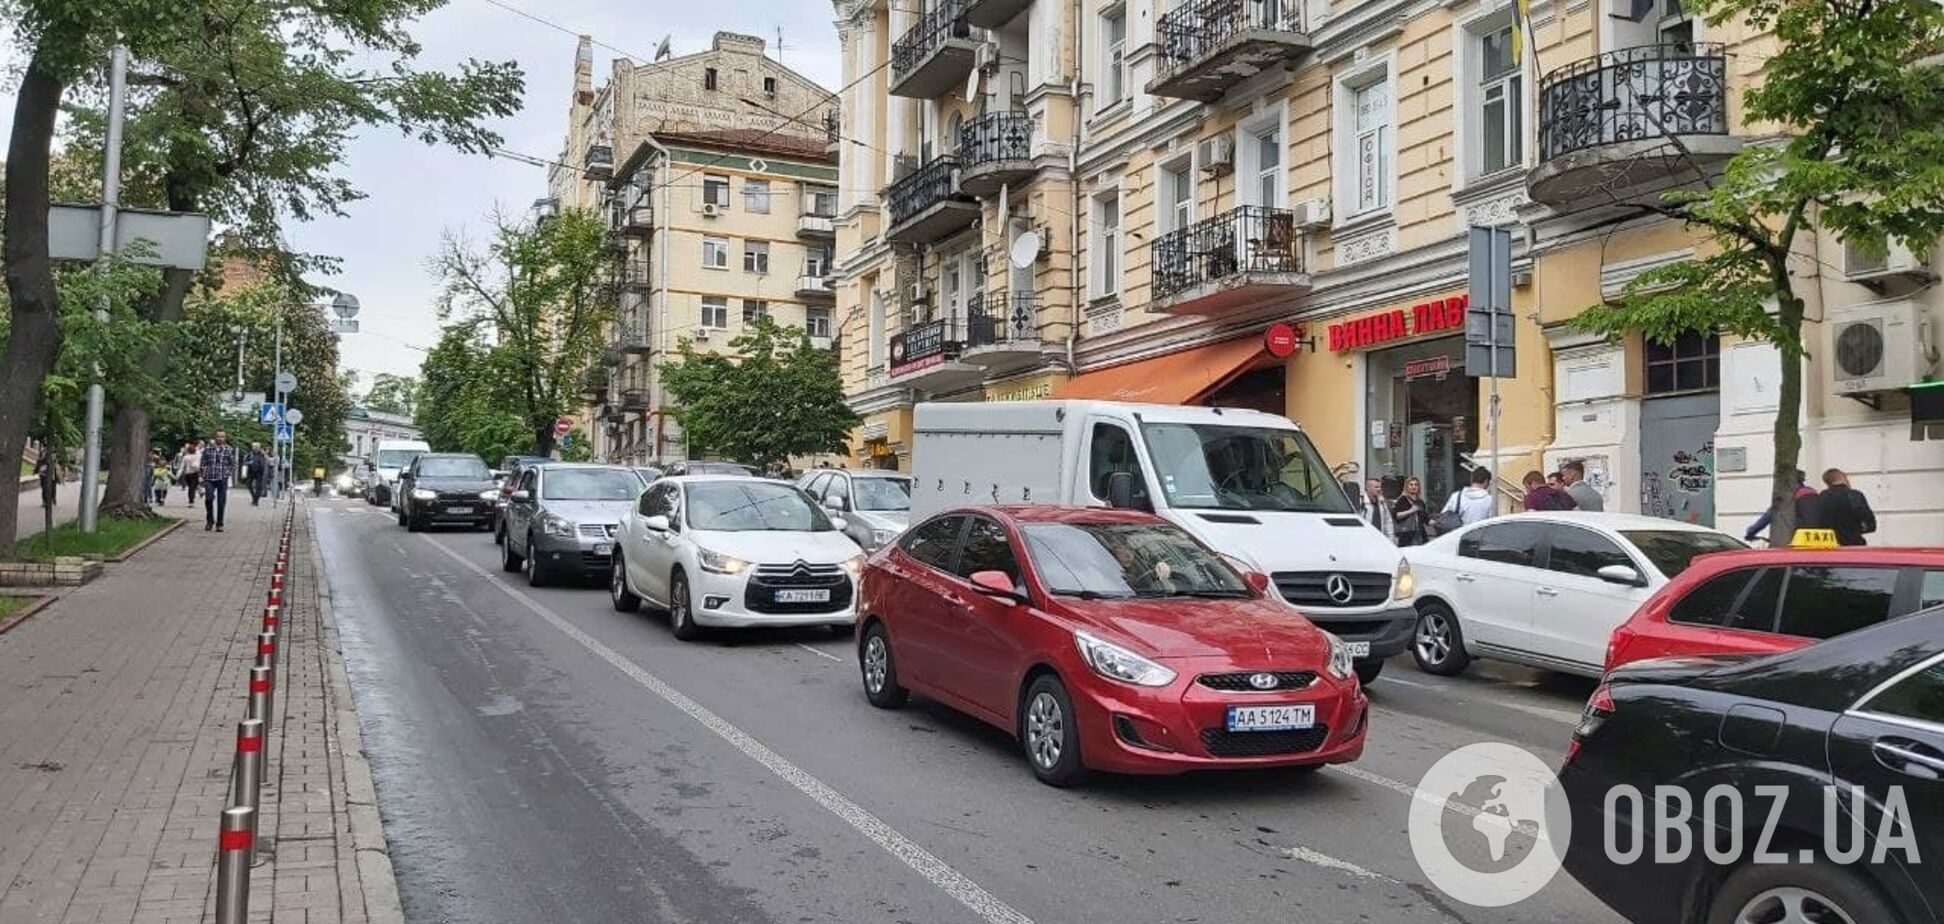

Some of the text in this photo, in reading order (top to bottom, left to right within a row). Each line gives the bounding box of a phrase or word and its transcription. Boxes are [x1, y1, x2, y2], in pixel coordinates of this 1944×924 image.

[1328, 310, 1407, 351] ВИННА
[1804, 531, 1835, 542] TAXI
[1237, 707, 1311, 726] AA 5124 TM
